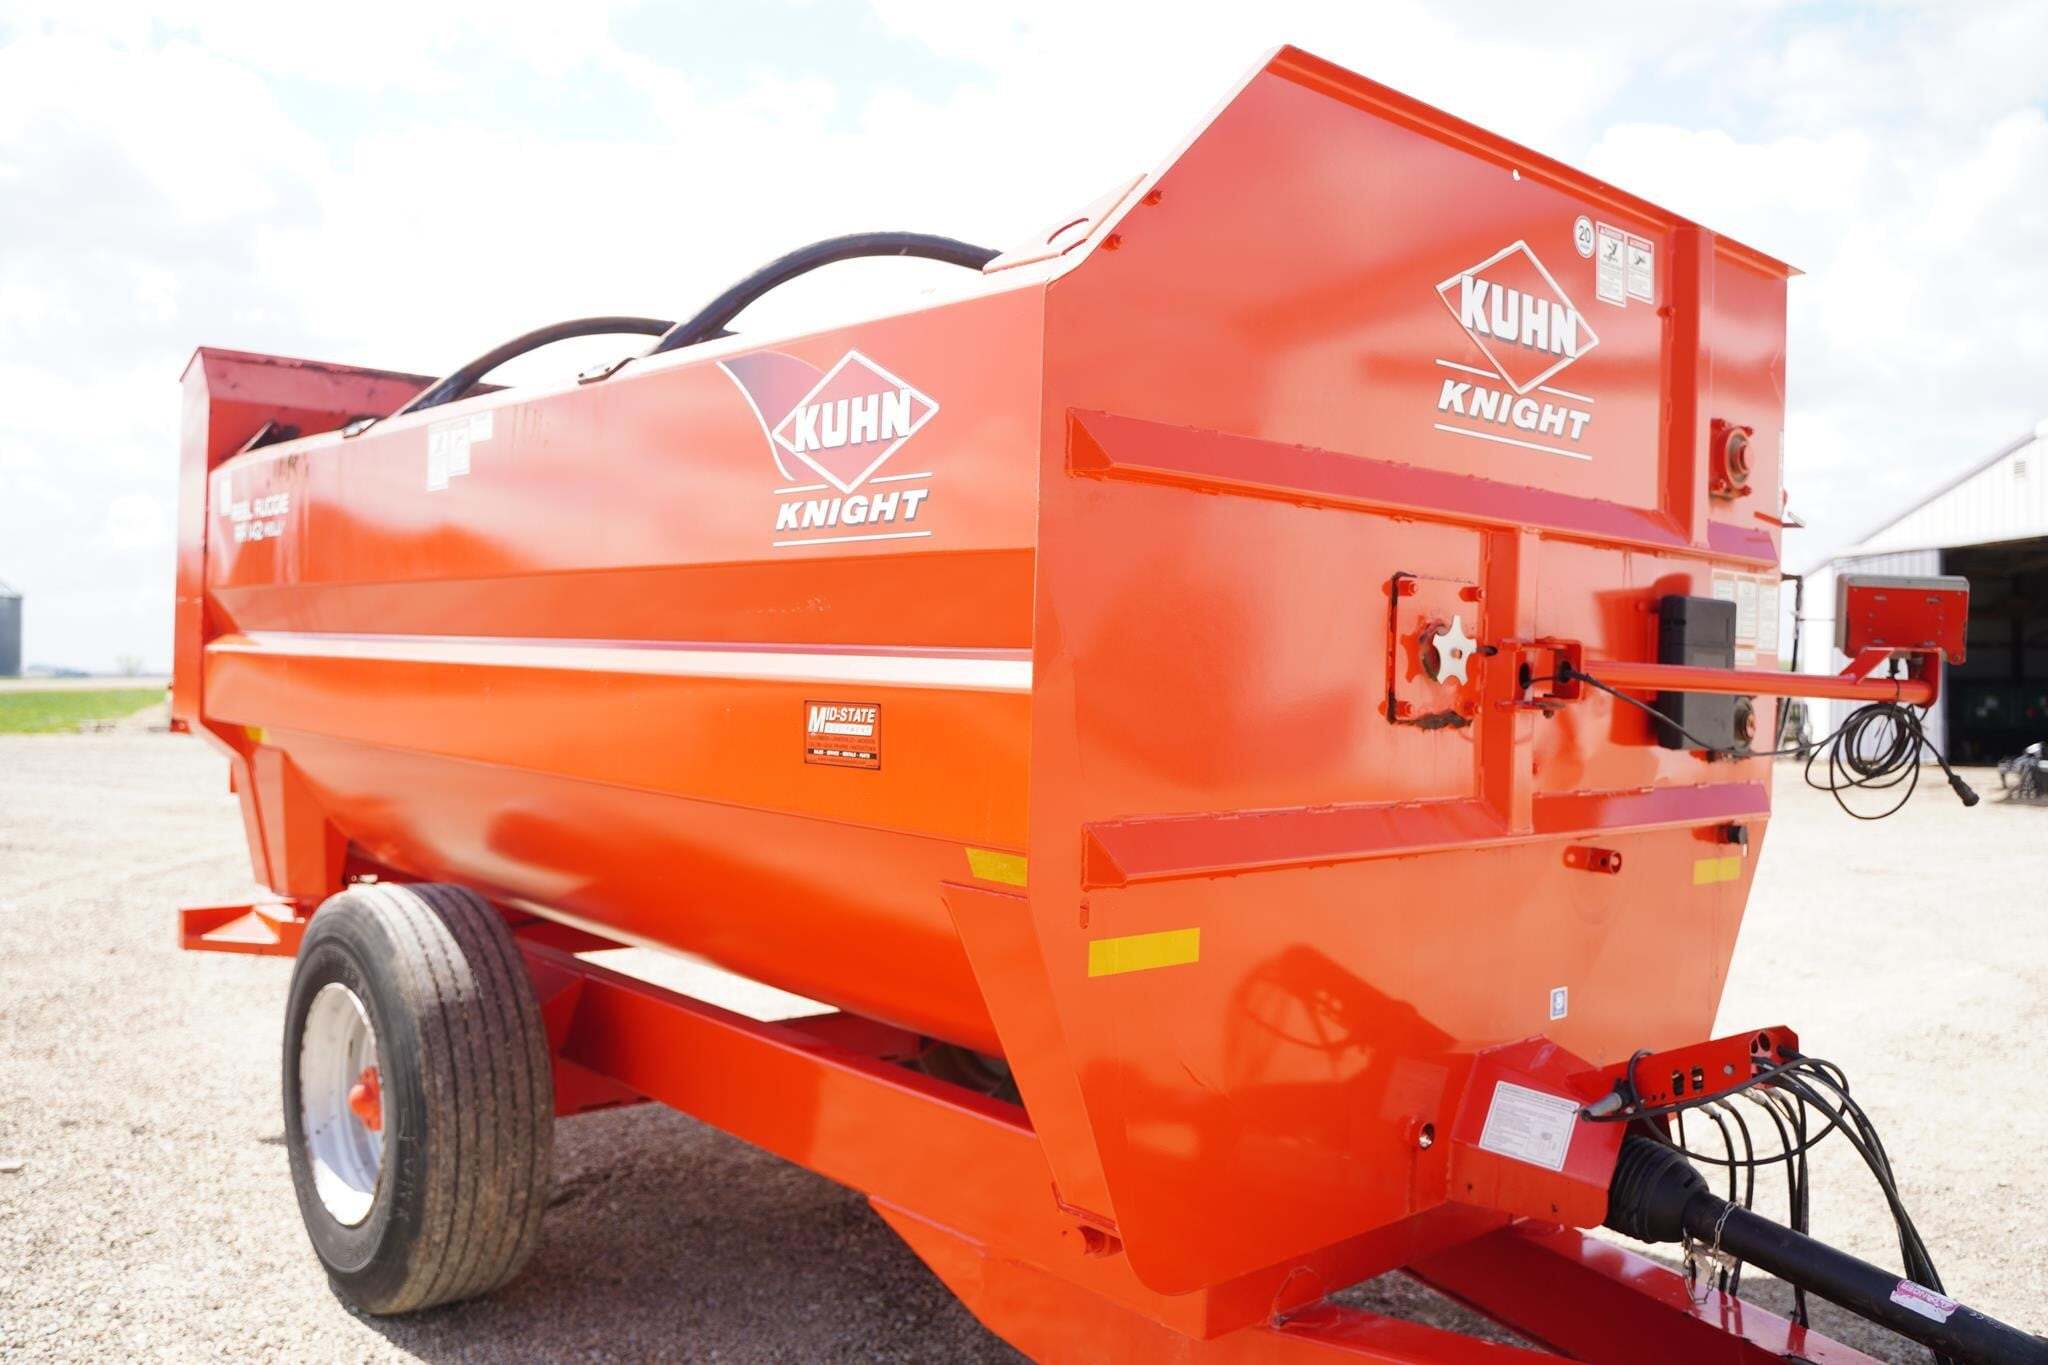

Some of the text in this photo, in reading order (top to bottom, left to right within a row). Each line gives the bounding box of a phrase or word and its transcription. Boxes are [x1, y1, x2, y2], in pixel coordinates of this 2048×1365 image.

[1578, 226, 1591, 243] 20
[1460, 274, 1578, 358] KUHN
[793, 388, 912, 452] KUHN
[1437, 379, 1590, 440] KNIGHT
[775, 489, 929, 530] KNIGHT
[808, 705, 877, 733] MID-STATE
